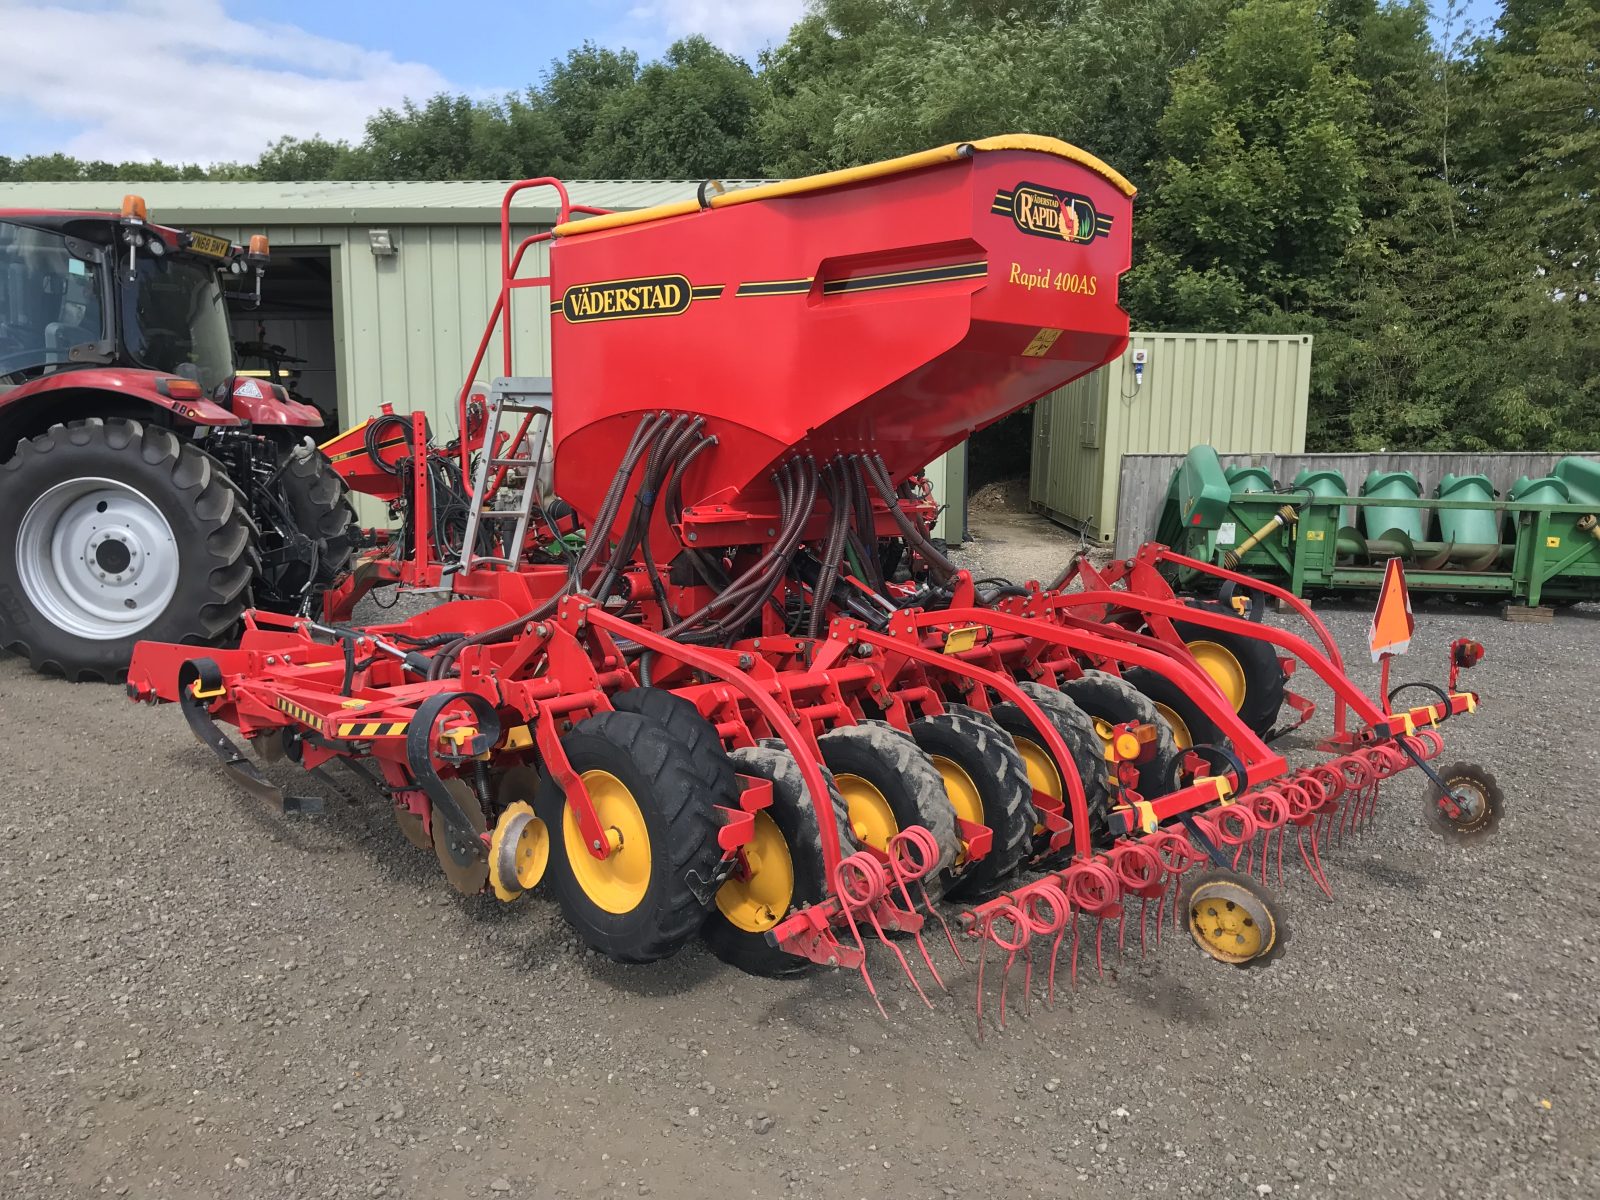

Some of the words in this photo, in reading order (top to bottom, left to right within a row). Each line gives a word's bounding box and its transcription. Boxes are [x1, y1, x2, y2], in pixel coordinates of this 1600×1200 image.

[1020, 192, 1058, 229] RAPID
[1031, 194, 1059, 208] VÄDERSTAD
[1009, 262, 1051, 290] Rapid
[1053, 272, 1097, 296] 400AS
[570, 283, 681, 316] VÄDERSTAD
